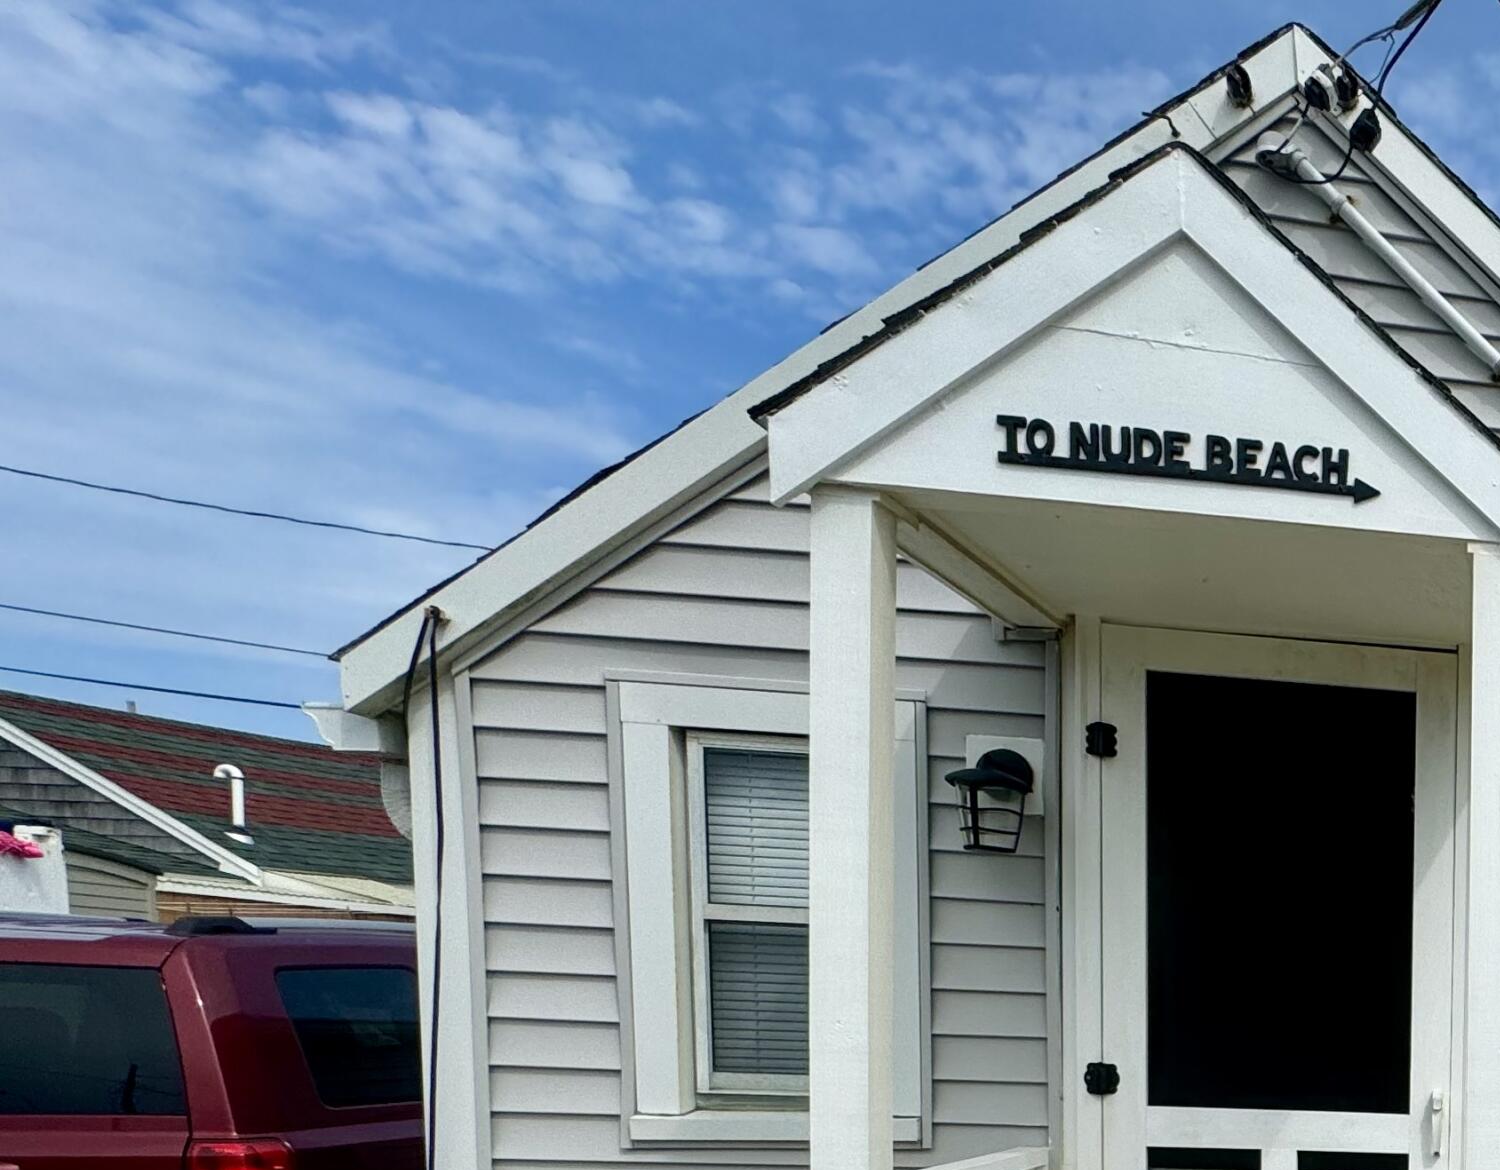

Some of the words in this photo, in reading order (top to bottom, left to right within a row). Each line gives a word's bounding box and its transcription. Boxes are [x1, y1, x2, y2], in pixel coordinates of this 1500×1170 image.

[997, 415, 1056, 458] TO
[1069, 421, 1191, 468] NUDE
[1206, 434, 1350, 485] BEACH
